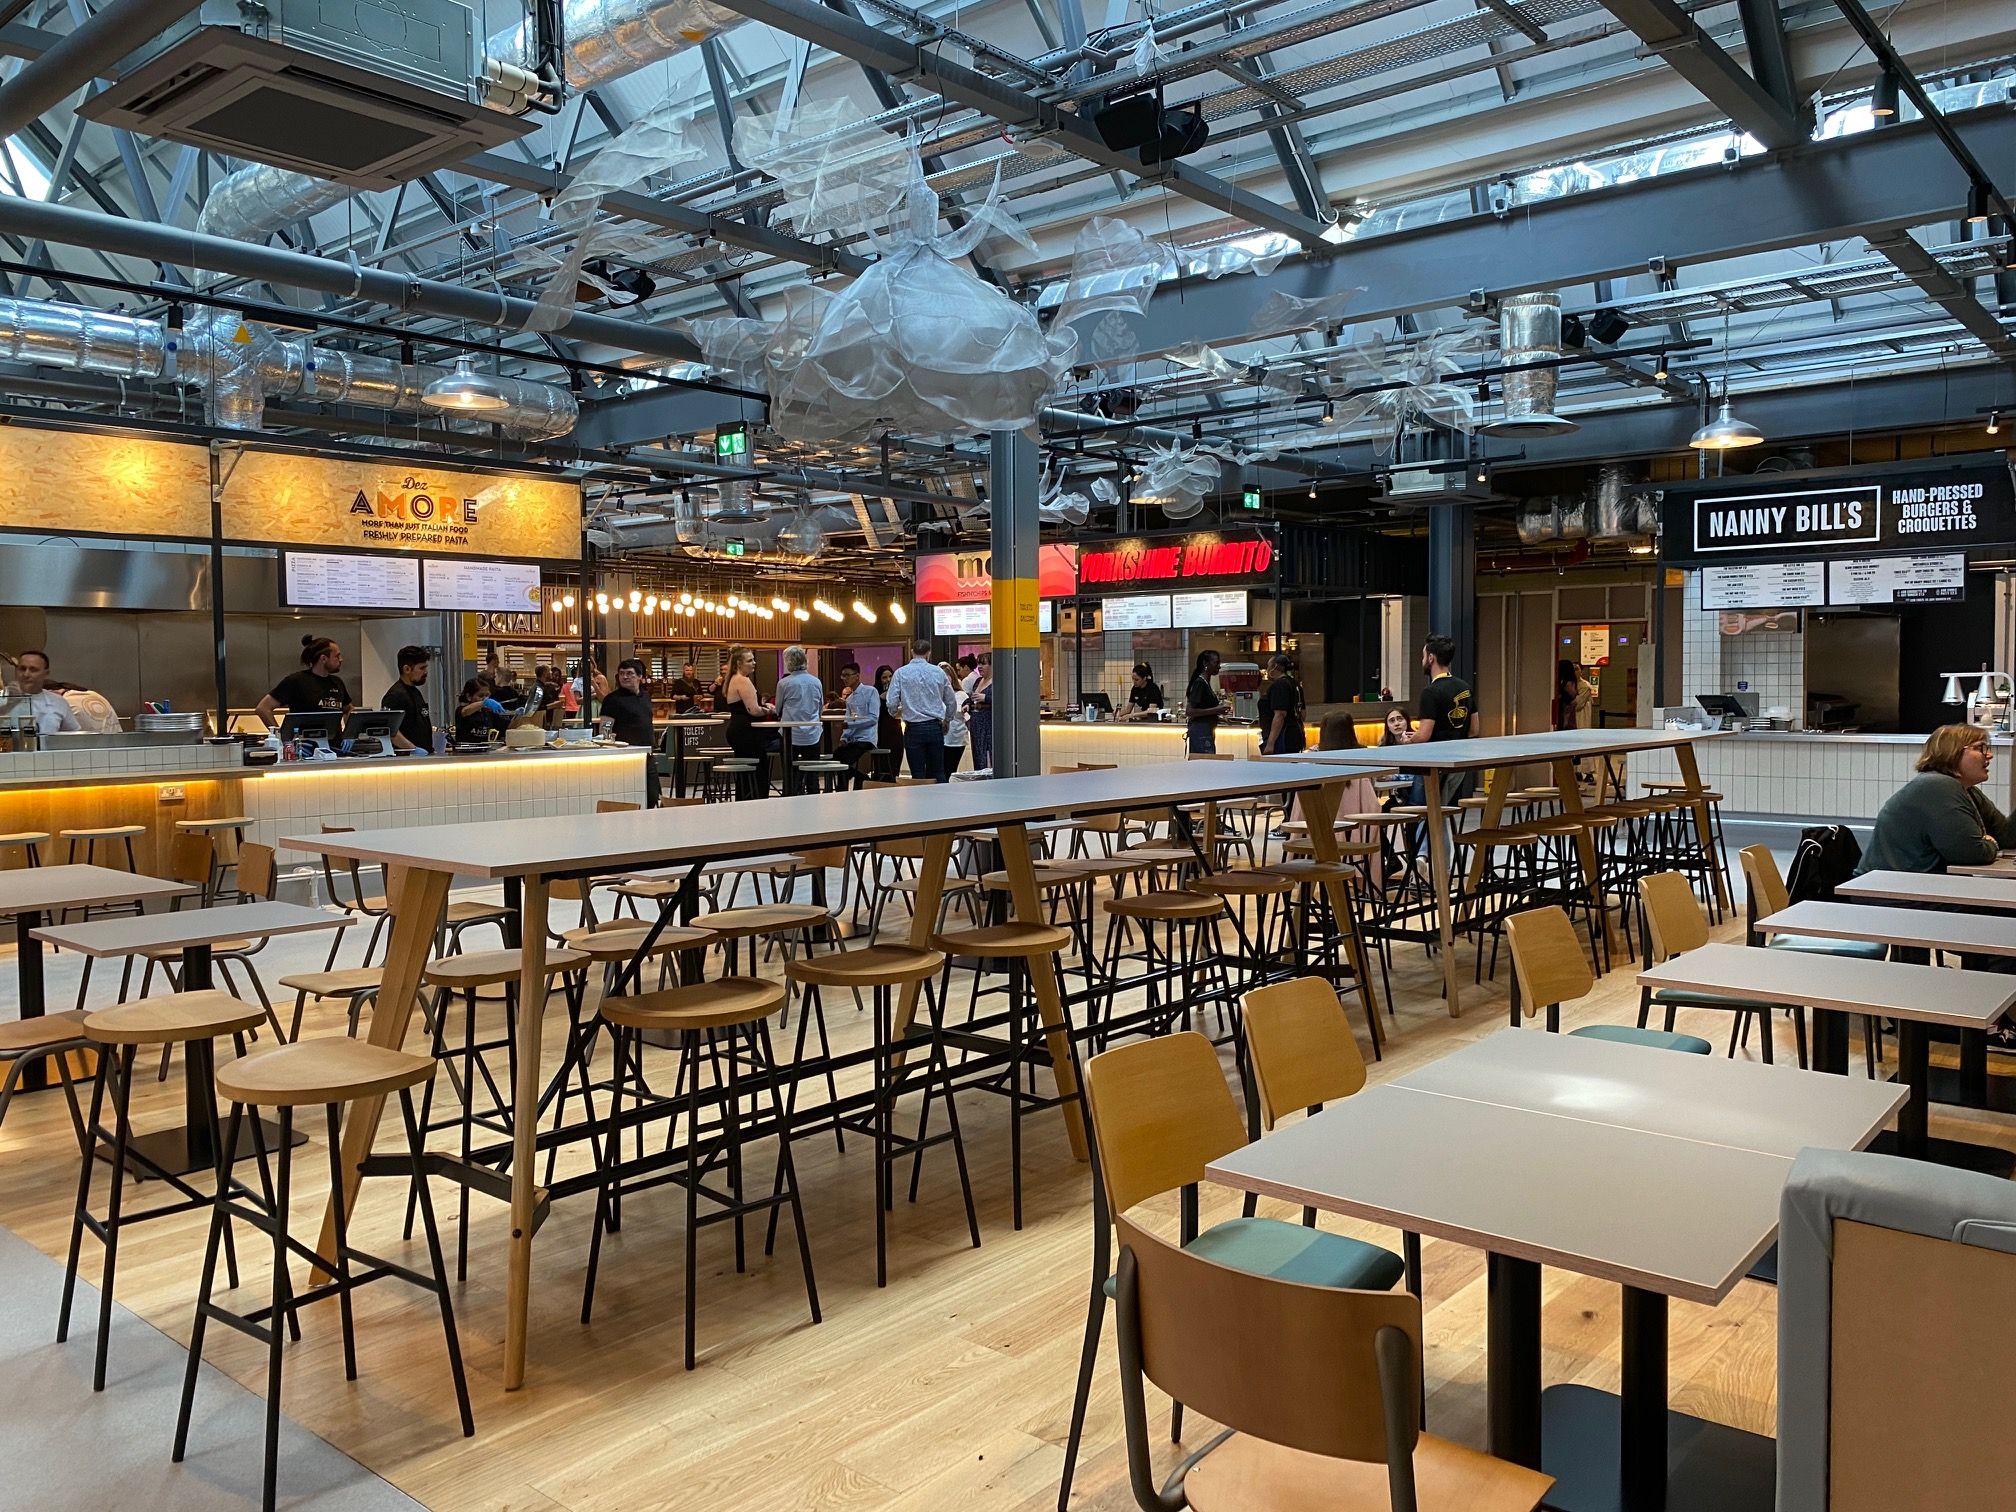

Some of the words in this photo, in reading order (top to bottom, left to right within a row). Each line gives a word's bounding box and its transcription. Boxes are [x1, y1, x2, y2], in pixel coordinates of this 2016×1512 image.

[402, 476, 428, 490] Dez
[1892, 483, 1983, 505] HAND-PRESSED
[350, 489, 478, 525] AMORE
[1902, 500, 1958, 519] BURGERS
[1962, 499, 1973, 515] &
[361, 519, 382, 528] MORE
[384, 520, 404, 529] THAN
[404, 522, 420, 531] JUST
[421, 524, 448, 533] ITALIAN
[449, 526, 469, 535] FOOD
[1709, 506, 1787, 538] NANNY
[1796, 501, 1863, 532] BILL'S
[1897, 515, 1977, 534] CROQUETTES
[363, 530, 399, 541] FRESHLY
[400, 532, 443, 543] PREPARED
[445, 535, 469, 545] PASTA
[1080, 546, 1183, 583] YORKSHIRE
[1182, 540, 1273, 577] BURRITO
[683, 726, 705, 736] TOILETS
[684, 736, 699, 746] LIFTS
